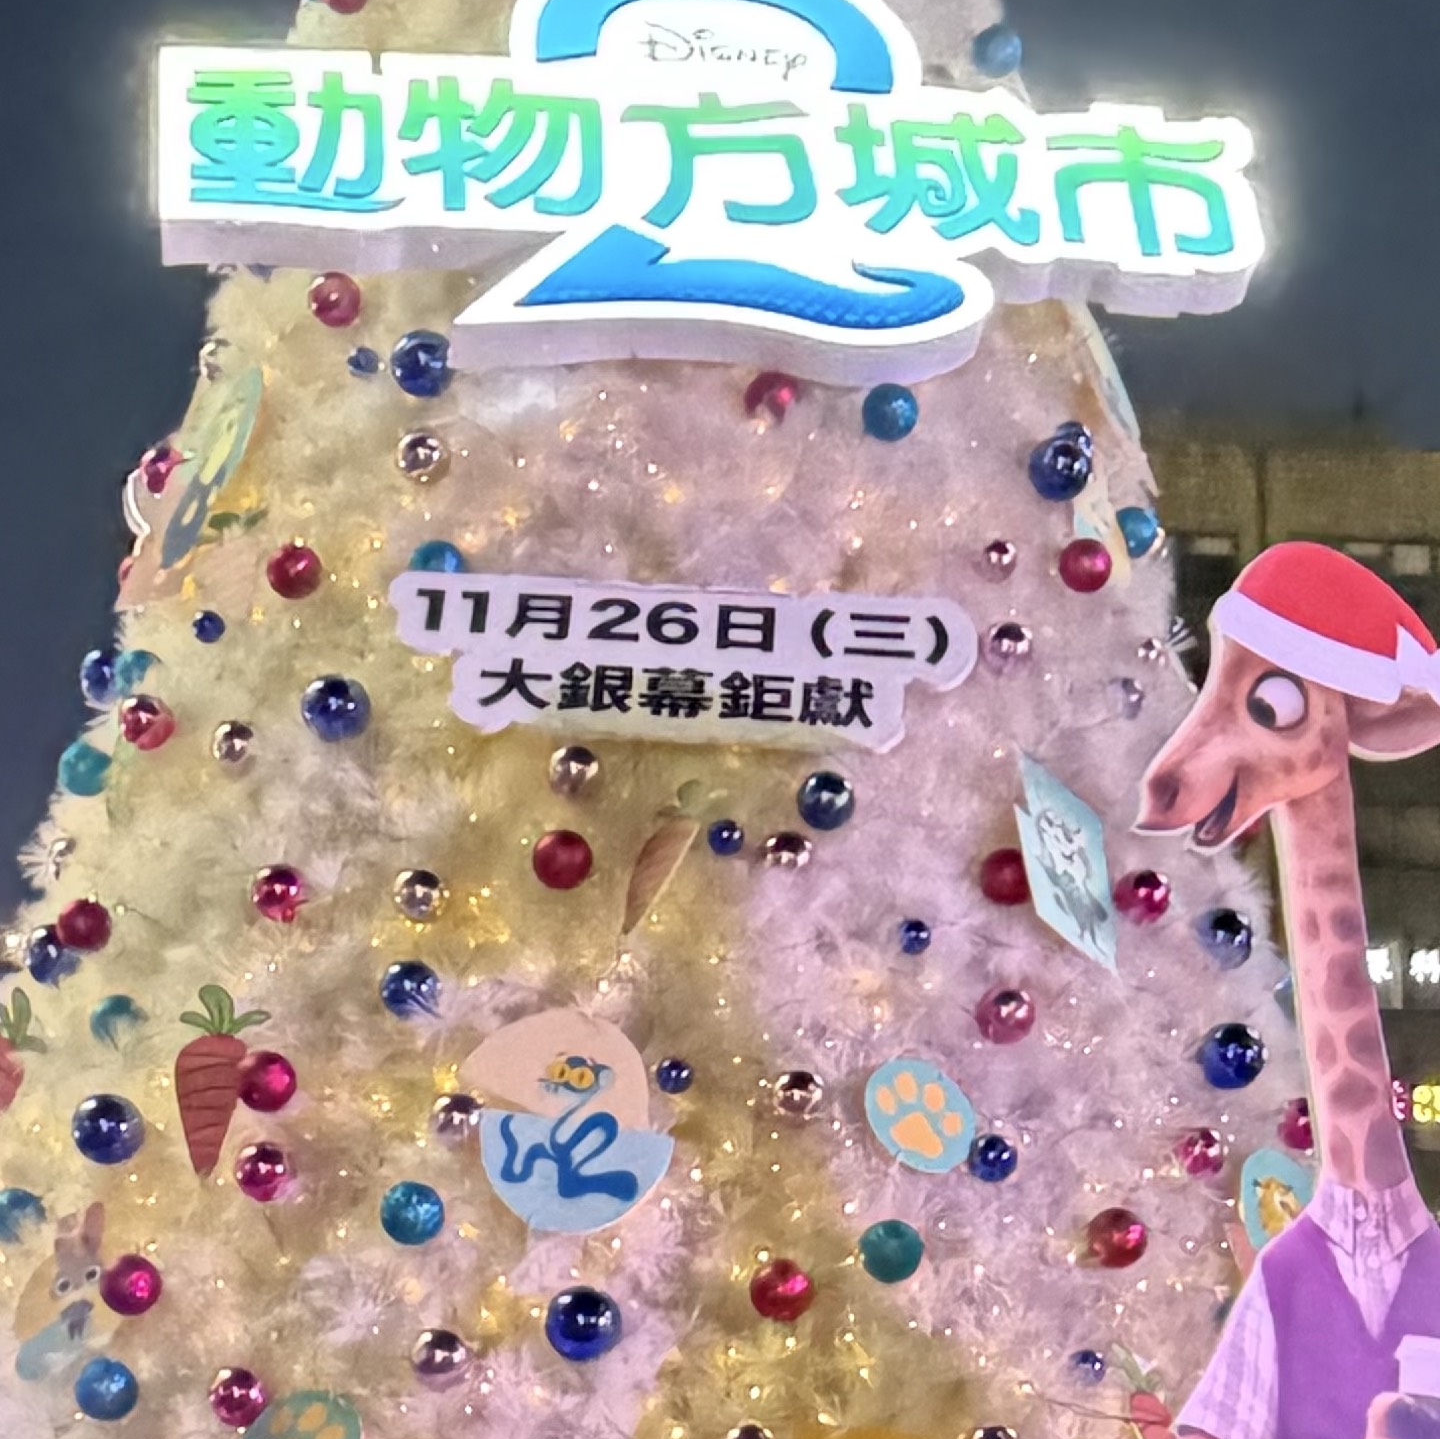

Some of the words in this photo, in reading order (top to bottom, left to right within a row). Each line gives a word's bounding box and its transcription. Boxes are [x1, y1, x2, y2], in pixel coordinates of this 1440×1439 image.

[186, 68, 1237, 257] 動物方城市
[479, 658, 875, 729] 大銀幕鉅獻
